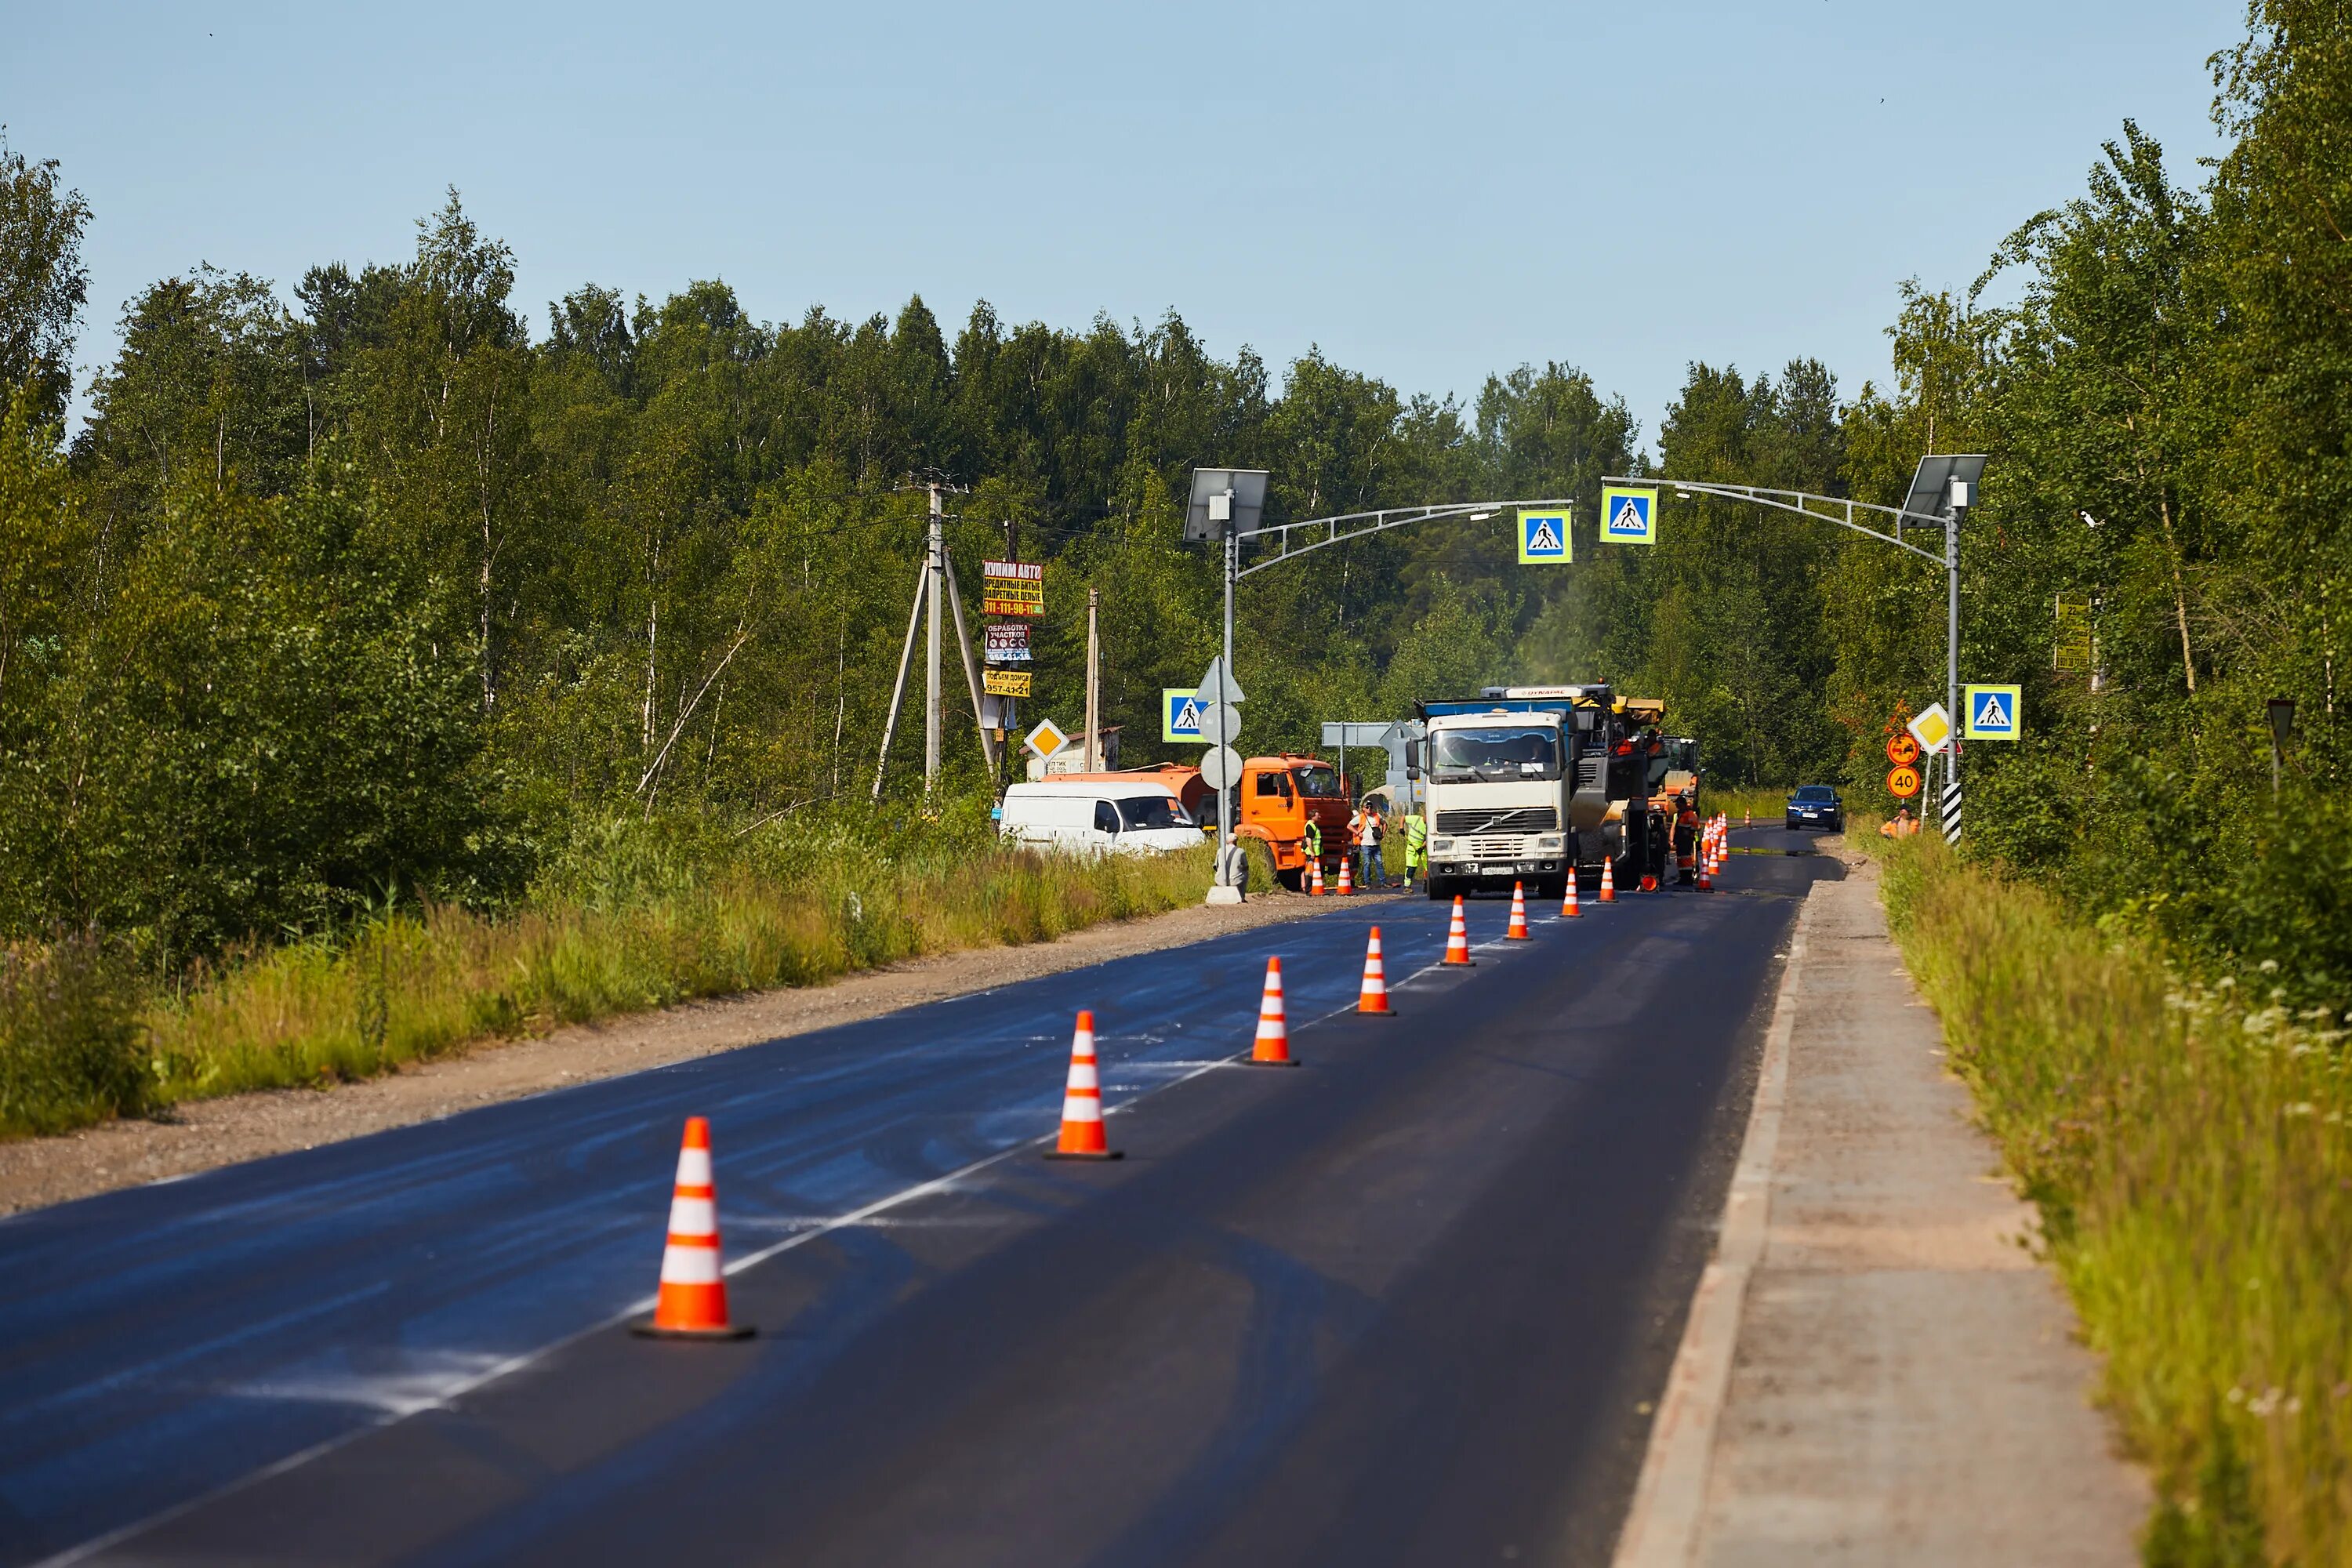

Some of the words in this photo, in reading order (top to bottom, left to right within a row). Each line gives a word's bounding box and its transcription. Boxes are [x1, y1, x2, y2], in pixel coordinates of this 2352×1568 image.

[985, 562, 1016, 578] КУПИМ
[1018, 564, 1041, 579] АВТО
[985, 578, 1019, 590] КРЕДИТНЫЕ
[1021, 581, 1040, 591] БИТЫЕ
[985, 590, 1019, 601] ЗАПРЕТНЫЕ
[1021, 592, 1040, 602] ЦЕЛЫЕ
[987, 684, 1029, 695] 957-41-21
[1895, 775, 1913, 788] 40
